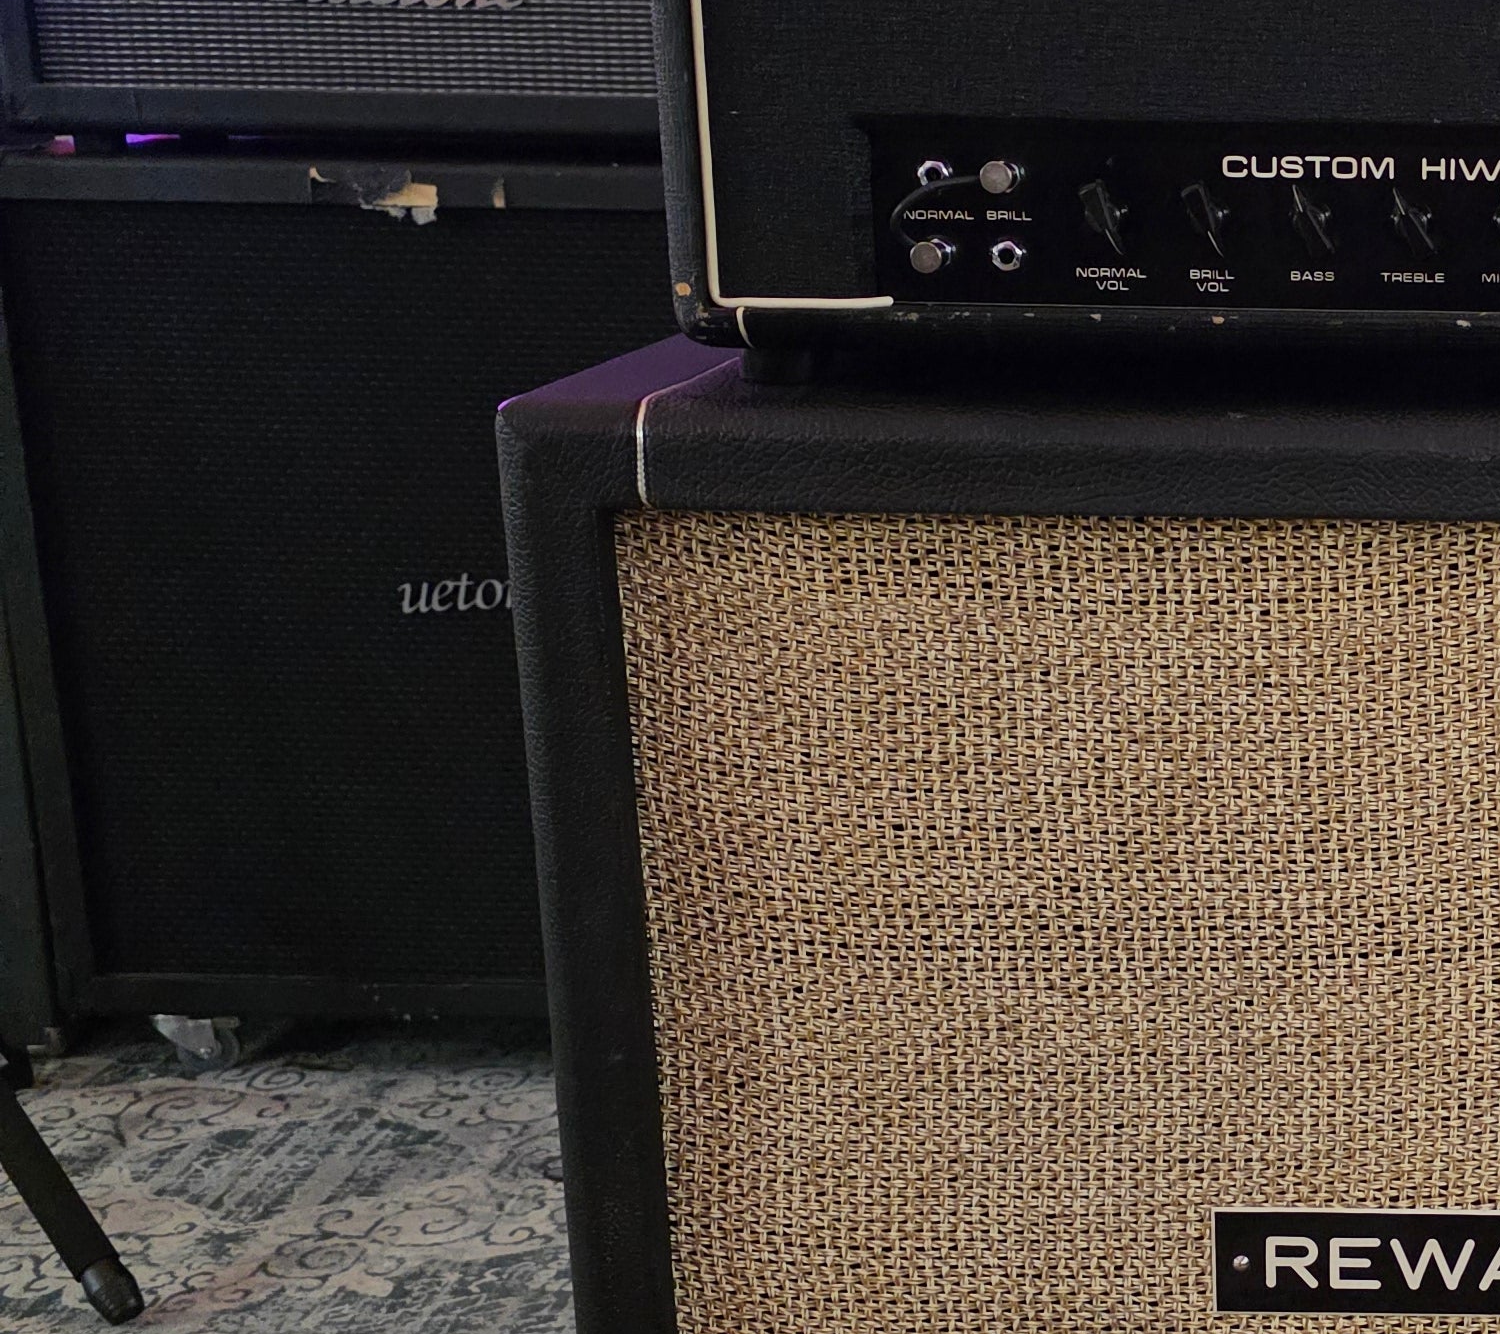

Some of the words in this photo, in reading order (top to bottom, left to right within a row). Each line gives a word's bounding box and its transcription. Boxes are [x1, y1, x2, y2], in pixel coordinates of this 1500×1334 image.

[1221, 154, 1396, 180] CUSTOM
[903, 209, 975, 221] NORMAL
[985, 209, 1033, 222] BRILL
[1075, 266, 1147, 279] NORMAL
[1189, 269, 1236, 281] BRILL
[1290, 270, 1336, 282] BASS
[1380, 271, 1446, 284] TREBLE
[1095, 280, 1130, 292] VOL
[1195, 281, 1230, 293] VOL
